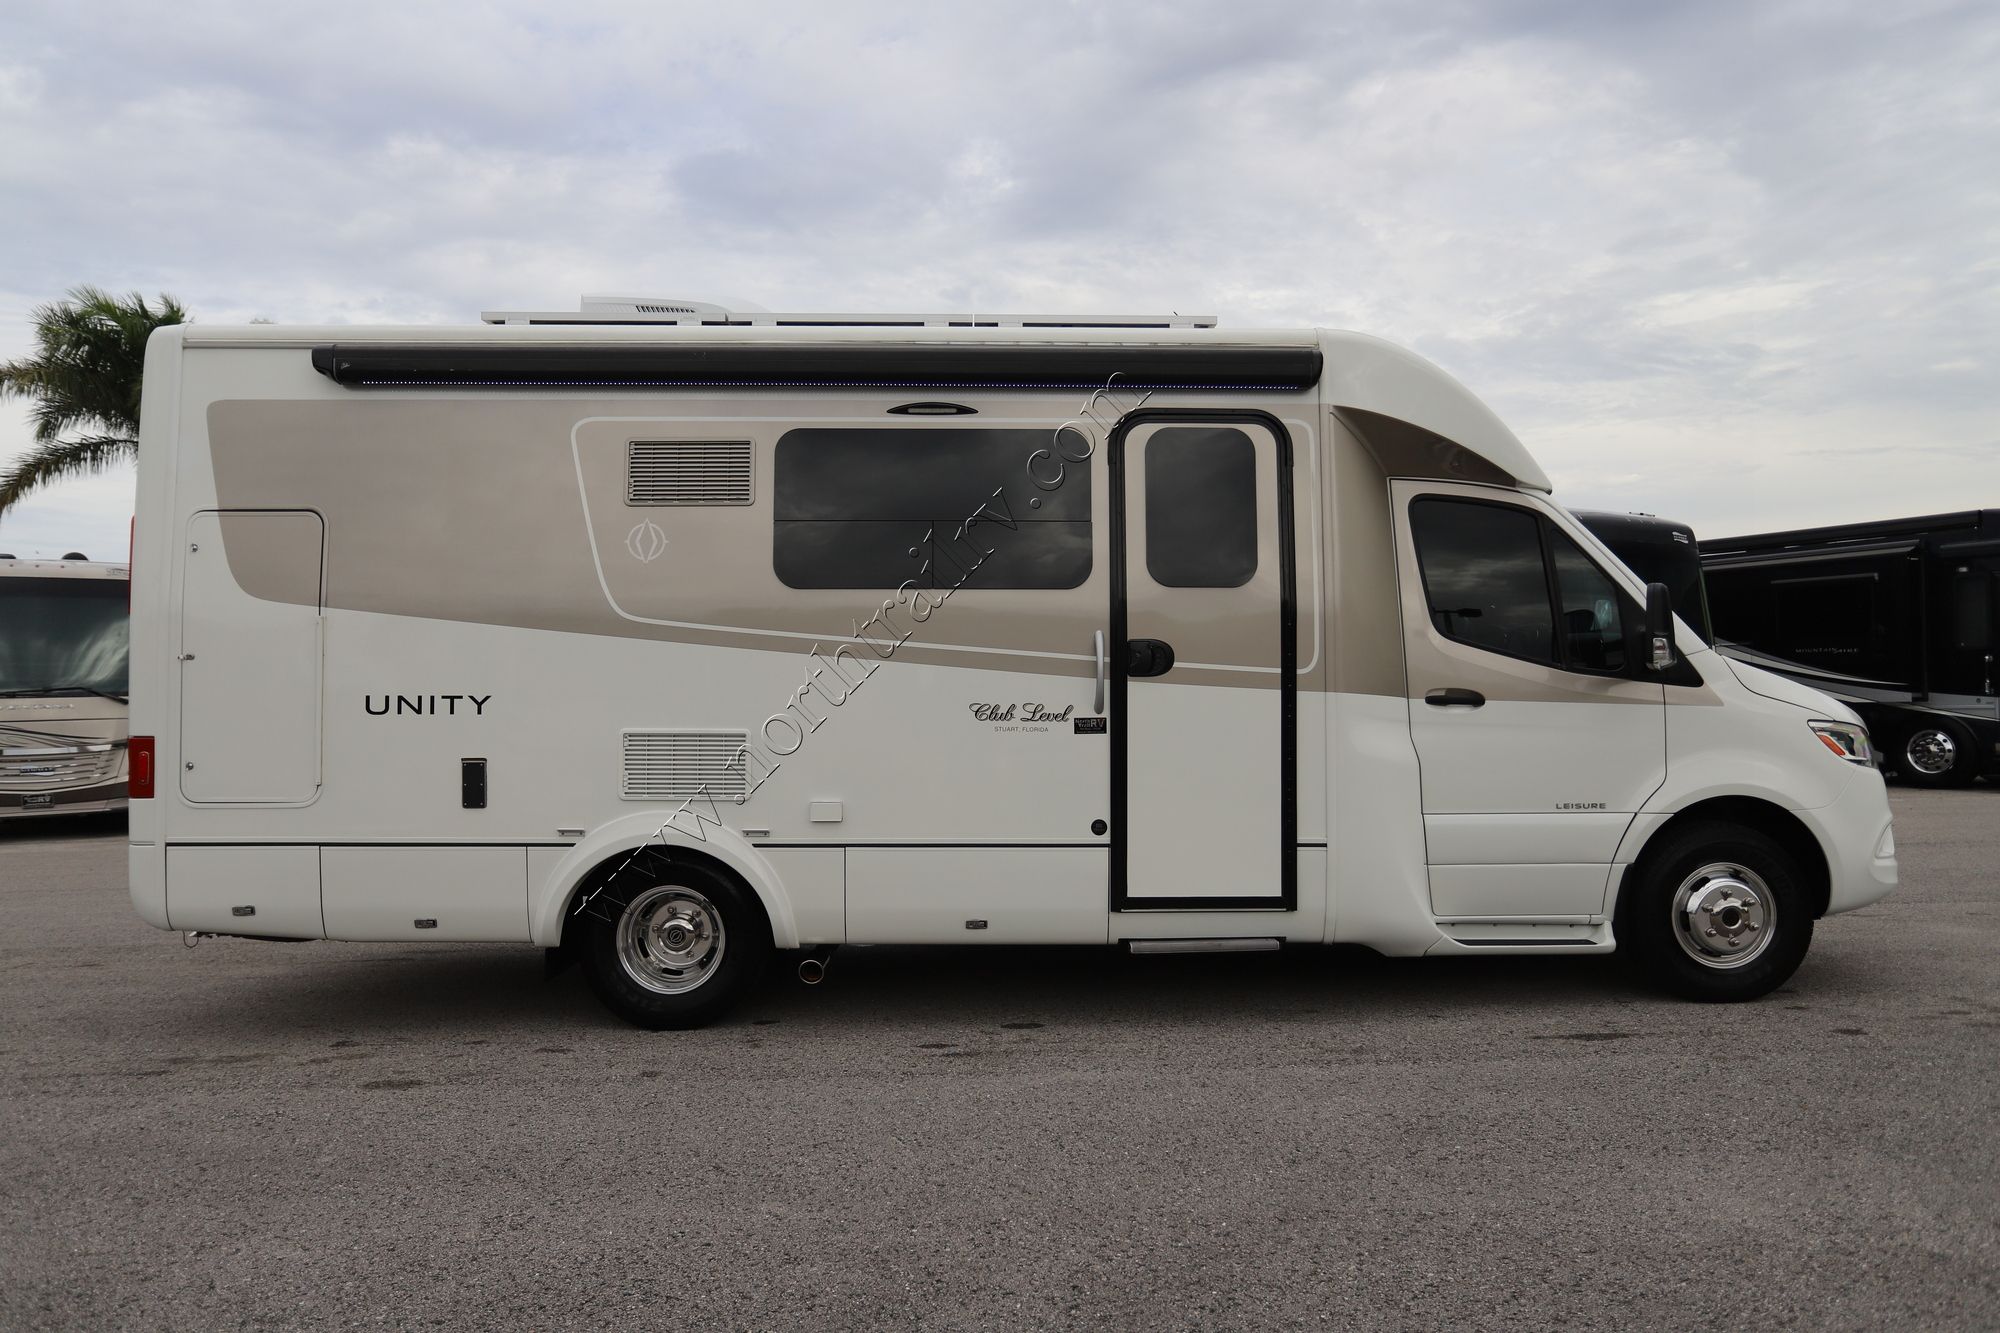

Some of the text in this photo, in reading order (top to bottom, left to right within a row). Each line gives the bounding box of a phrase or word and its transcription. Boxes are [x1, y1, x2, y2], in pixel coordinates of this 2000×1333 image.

[365, 695, 492, 715] UNITY
[968, 702, 1075, 723] Club Level
[1555, 802, 1607, 810] LEISURE
